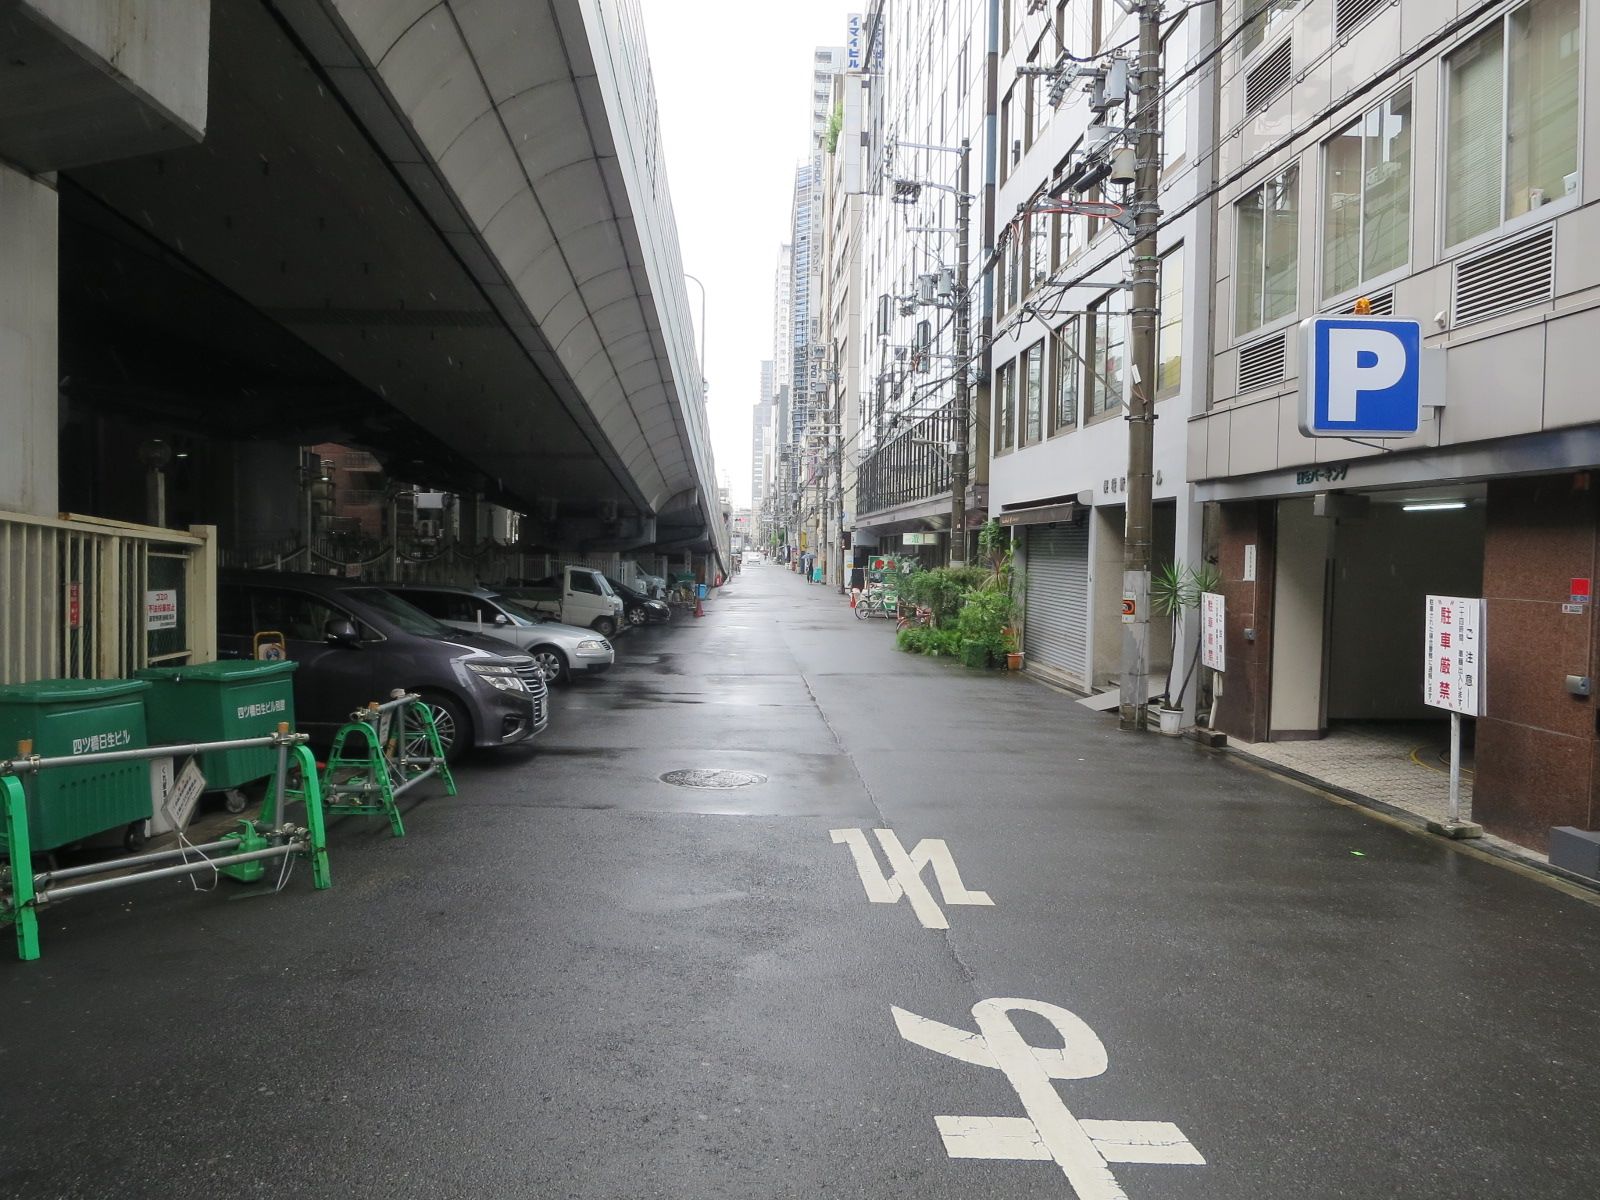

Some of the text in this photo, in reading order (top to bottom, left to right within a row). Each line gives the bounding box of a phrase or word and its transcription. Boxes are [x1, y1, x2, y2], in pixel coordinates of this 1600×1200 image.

[848, 16, 860, 68] イマイビル
[1327, 328, 1407, 422] P
[1439, 606, 1452, 700] 駐車厳禁
[1465, 628, 1474, 687] ご注意
